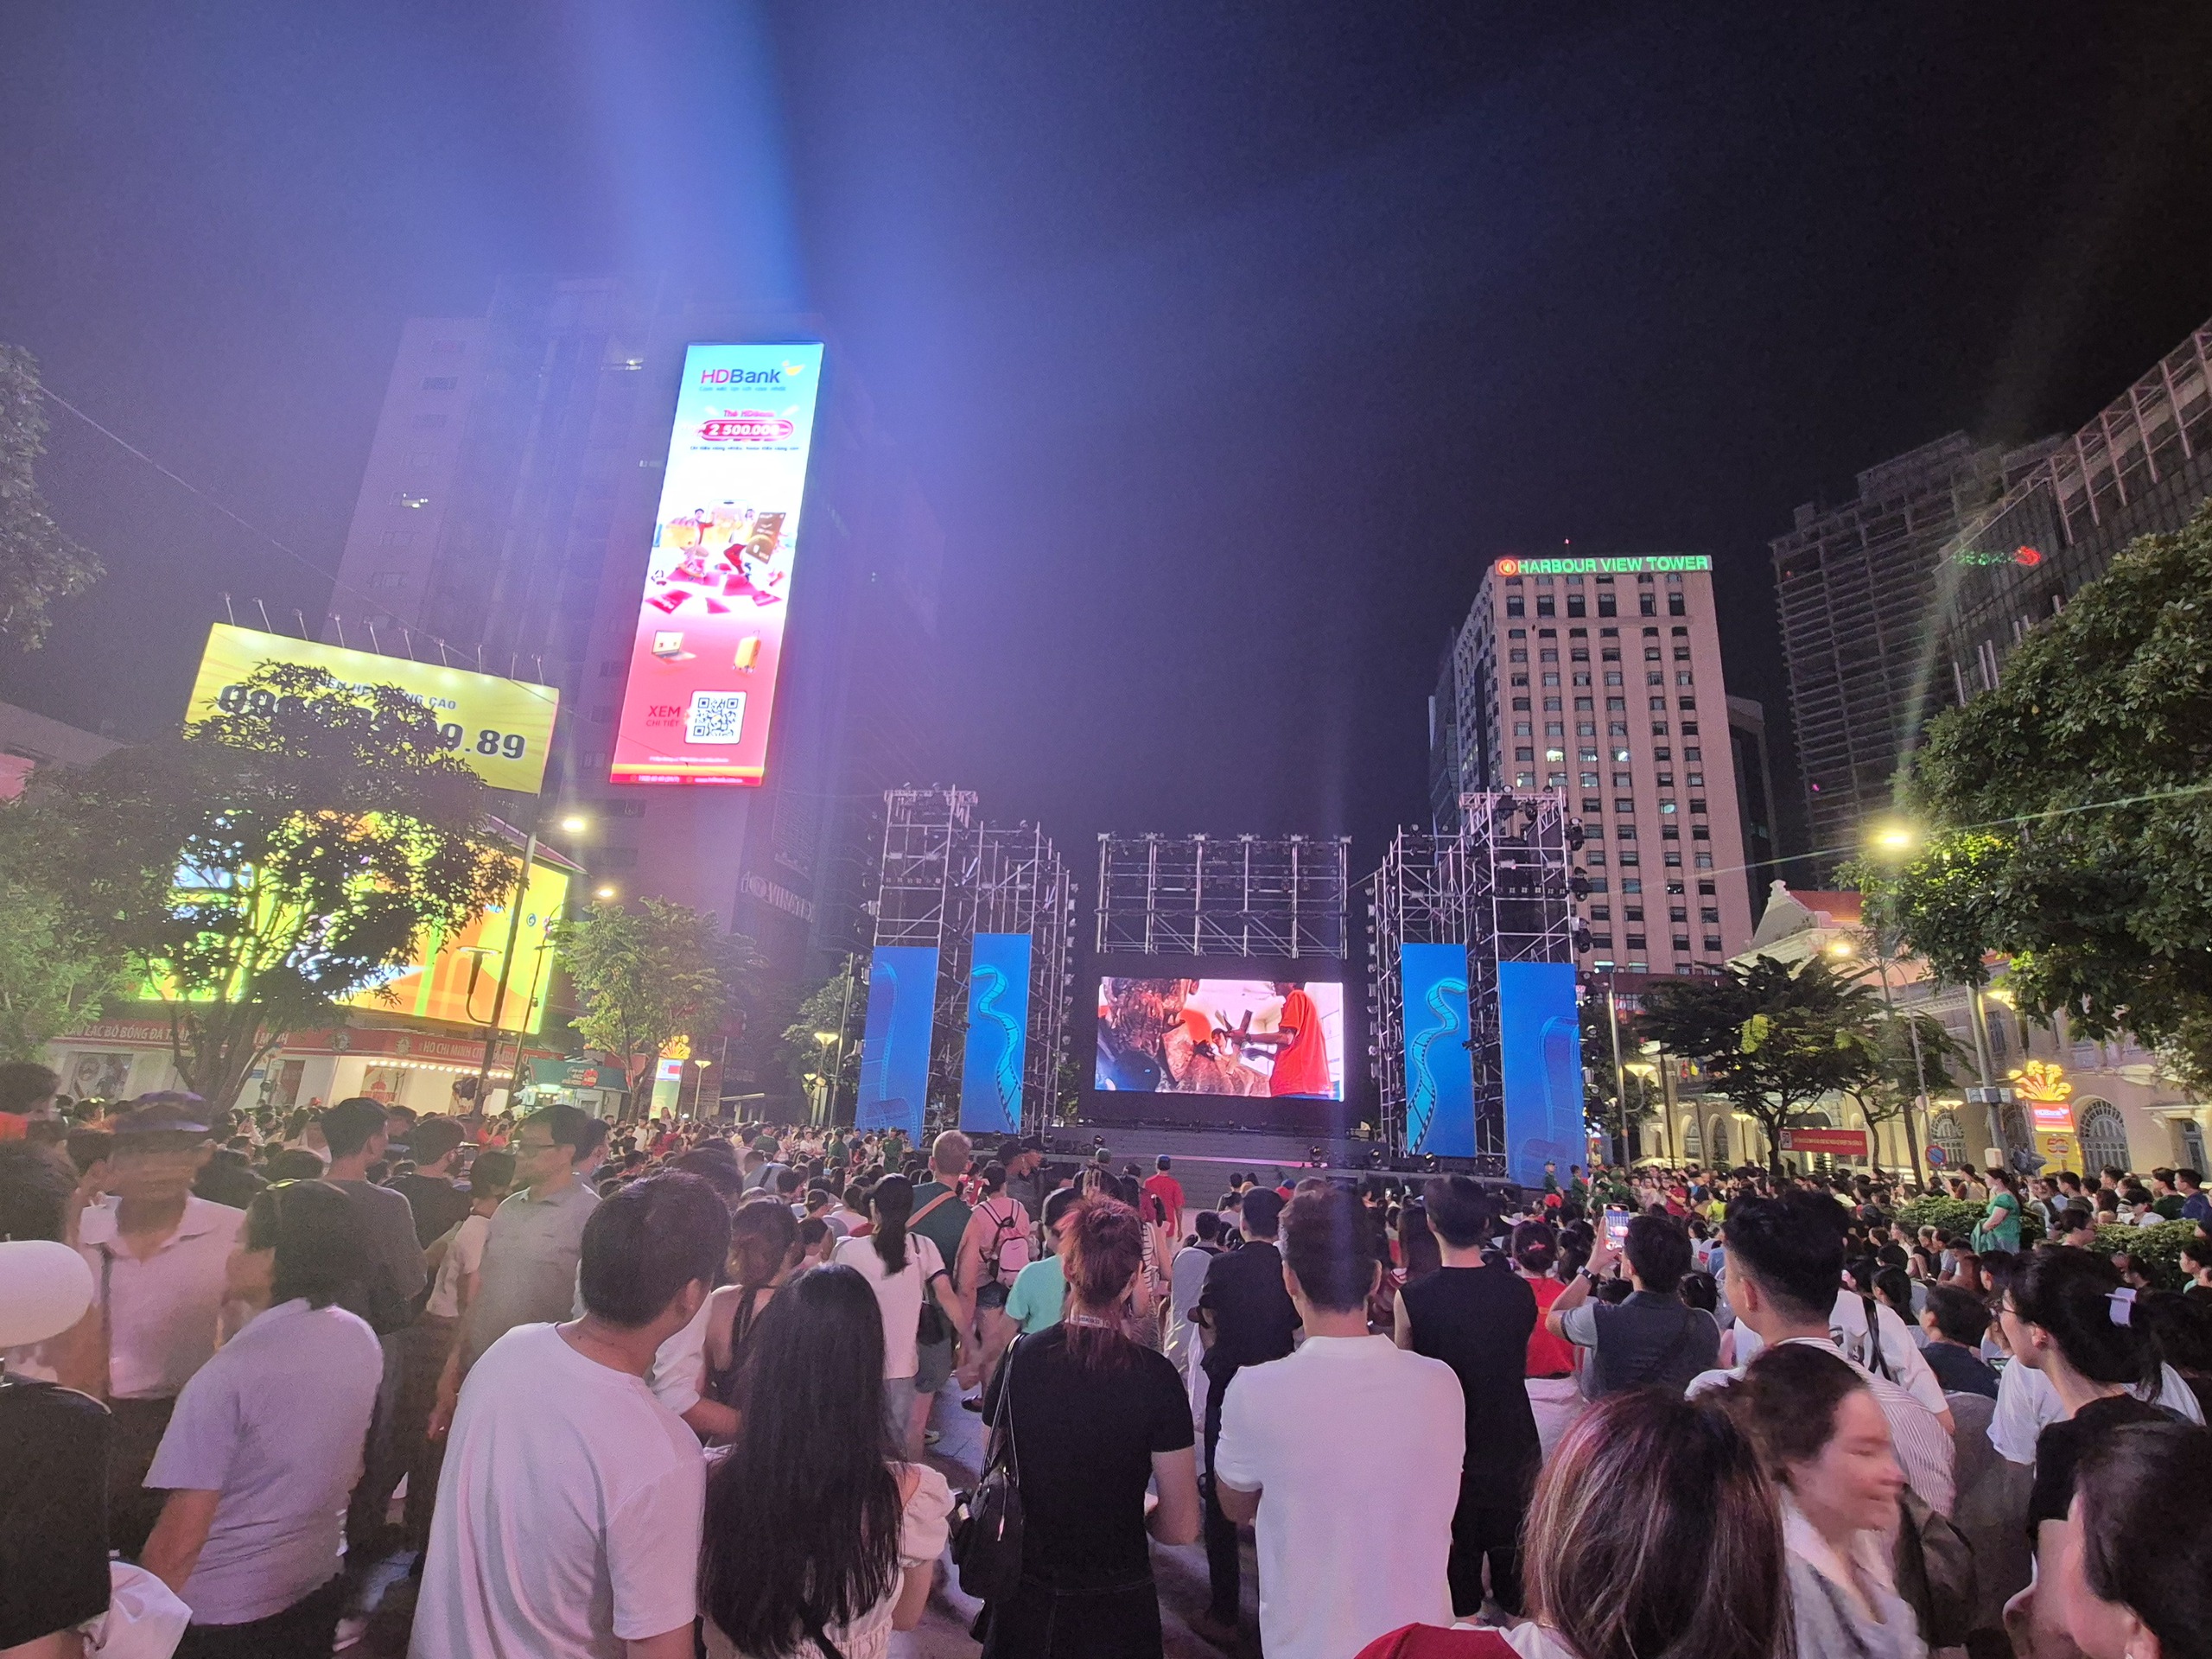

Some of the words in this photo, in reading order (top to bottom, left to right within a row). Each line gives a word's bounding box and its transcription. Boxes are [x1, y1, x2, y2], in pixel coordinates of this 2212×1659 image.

[701, 368, 781, 385] HDBank
[1517, 558, 1597, 574] HARBOUR
[1600, 556, 1643, 572] VIEW
[1646, 555, 1708, 571] TOWER
[648, 705, 681, 718] XEM
